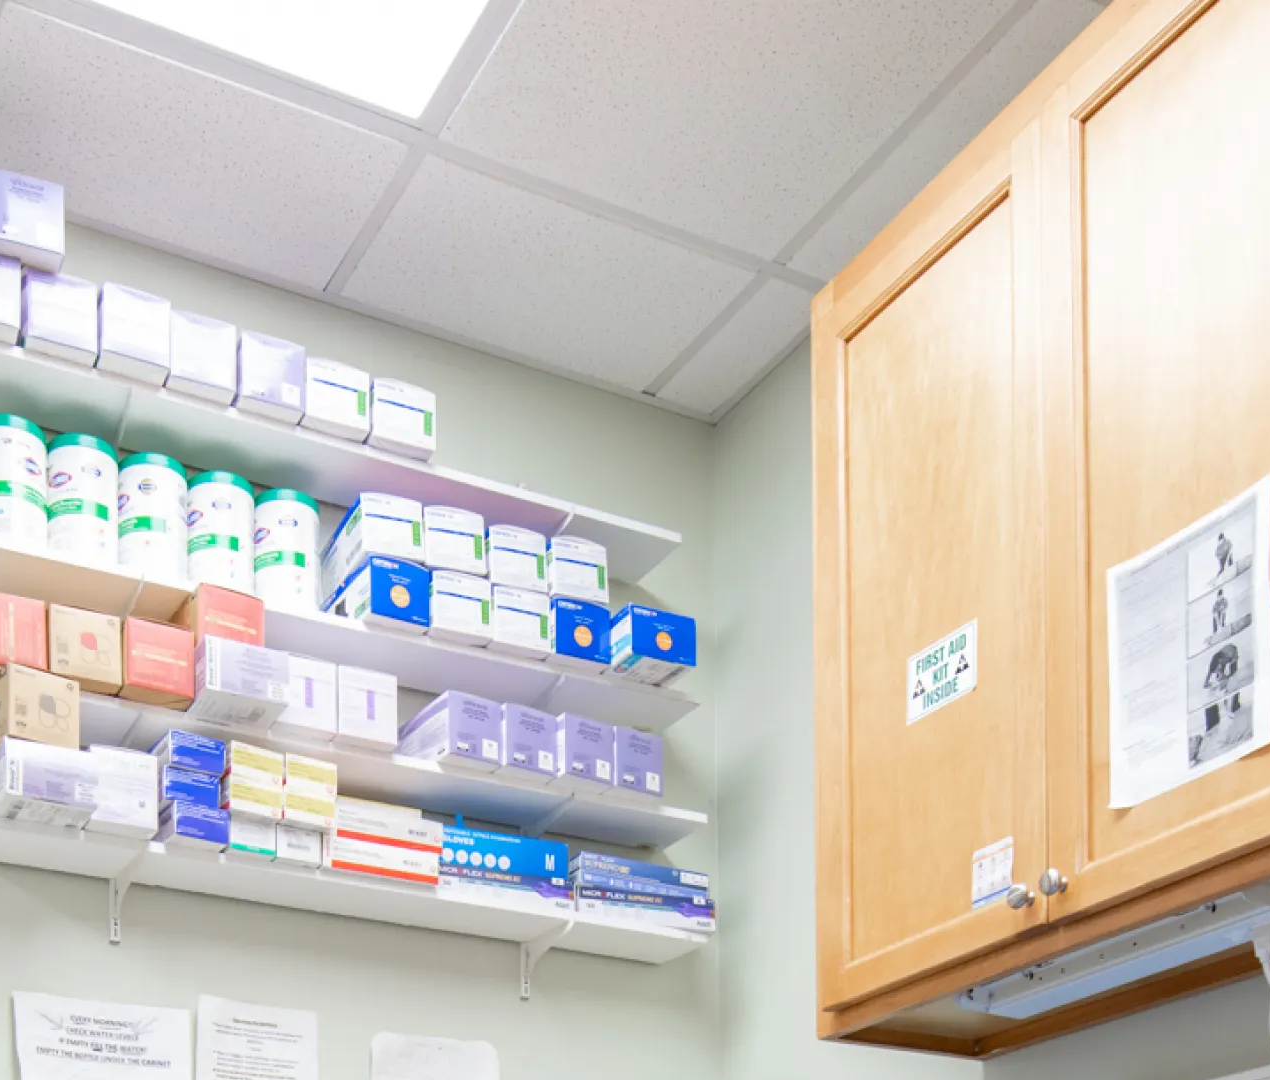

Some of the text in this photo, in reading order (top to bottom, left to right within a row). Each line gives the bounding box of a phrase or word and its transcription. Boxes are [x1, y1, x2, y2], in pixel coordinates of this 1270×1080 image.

[917, 634, 967, 675] FIRST AID
[933, 662, 949, 684] KIT
[924, 676, 959, 709] INSIDE
[545, 853, 555, 871] M
